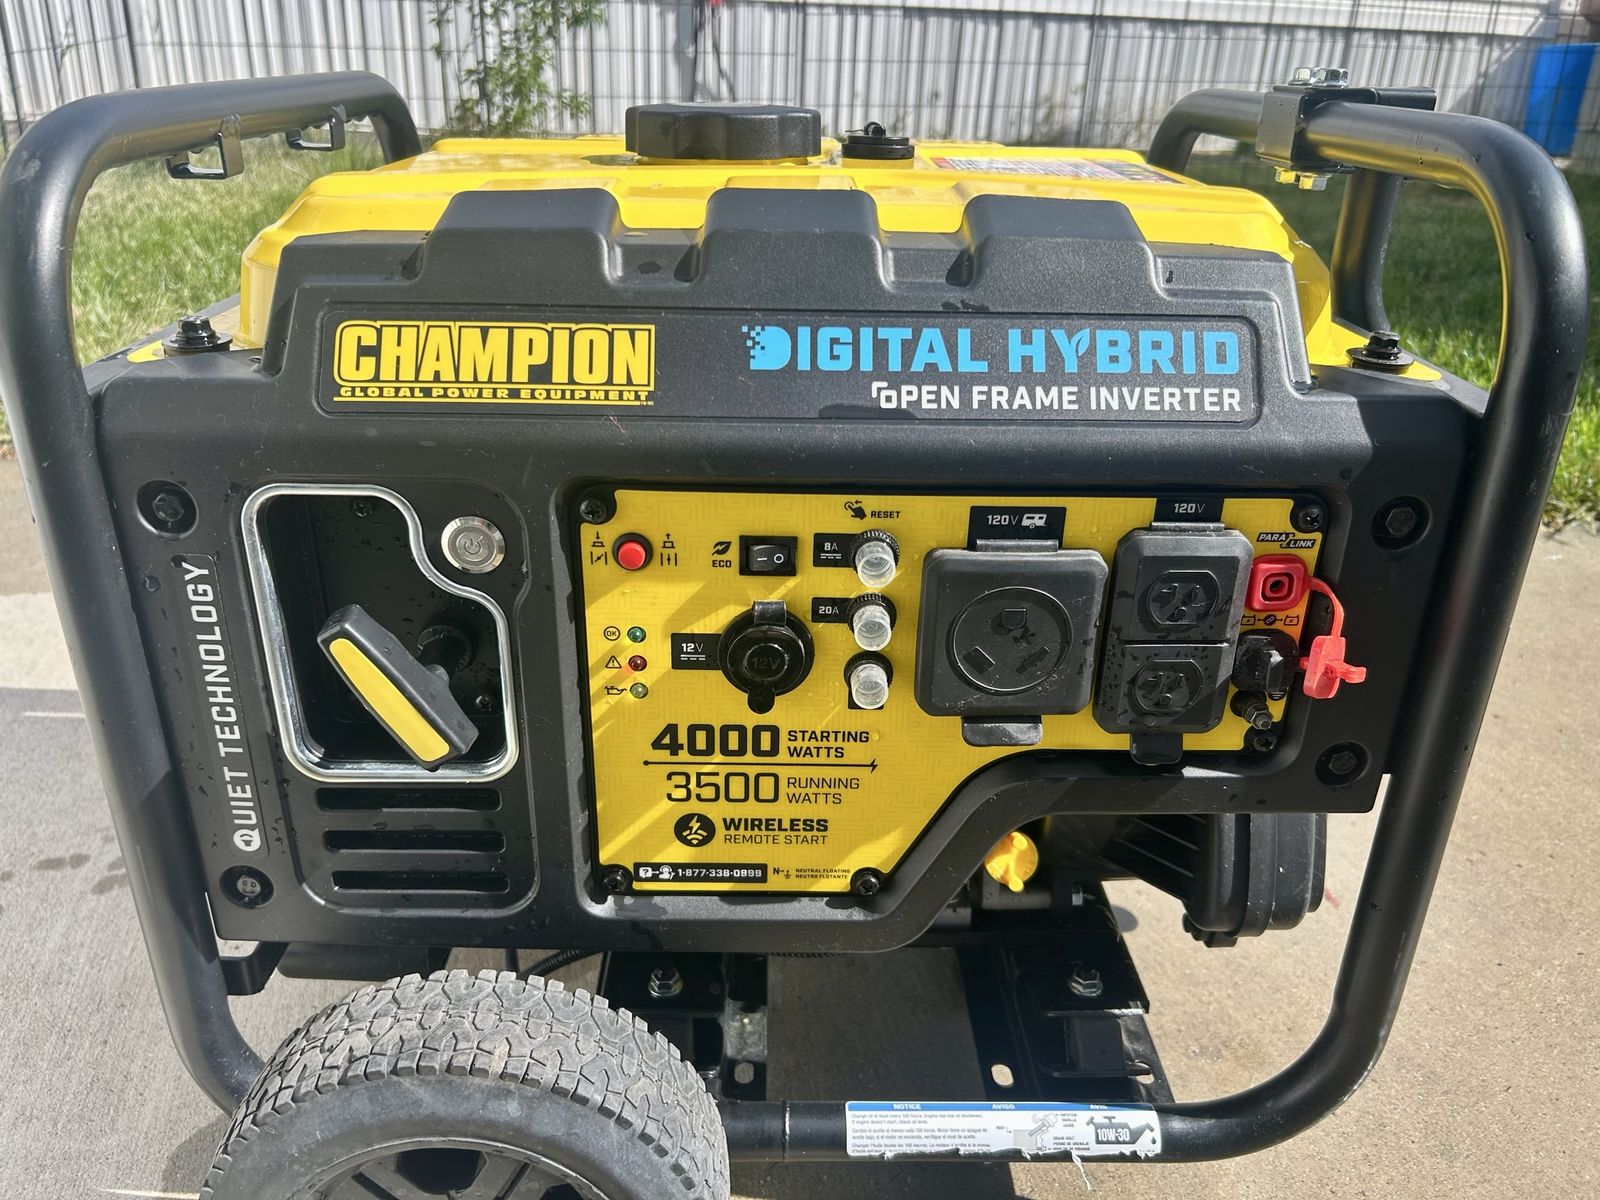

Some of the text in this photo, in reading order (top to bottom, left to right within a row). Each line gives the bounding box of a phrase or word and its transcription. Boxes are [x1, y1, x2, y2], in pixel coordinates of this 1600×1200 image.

[338, 324, 652, 386] CHAMPION
[742, 325, 1240, 375] DIGITAL HYBRID
[340, 387, 649, 401] GLOBAL POWER EQUIPMENT
[872, 381, 1242, 412] OPEN FRAME INVERTER
[870, 510, 901, 519] RESET
[1174, 503, 1205, 514] 120V
[986, 514, 1018, 526] 120V
[824, 542, 838, 551] 8A
[1289, 540, 1314, 548] LINK
[712, 559, 732, 568] ECO
[818, 606, 839, 614] 20A
[681, 643, 704, 652] 12V
[752, 657, 782, 669] 12V
[181, 561, 262, 852] QUIET TECHNOLOGY
[650, 723, 780, 757] 4000
[787, 730, 870, 743] STARTING
[787, 746, 845, 758] WATTS
[666, 771, 780, 803] 3500
[787, 777, 860, 790] RUNNING
[787, 792, 842, 805] WATTS
[722, 818, 829, 832] WIRELESS
[724, 834, 828, 845] REMOTE START
[1096, 1128, 1130, 1141] 10W-30
